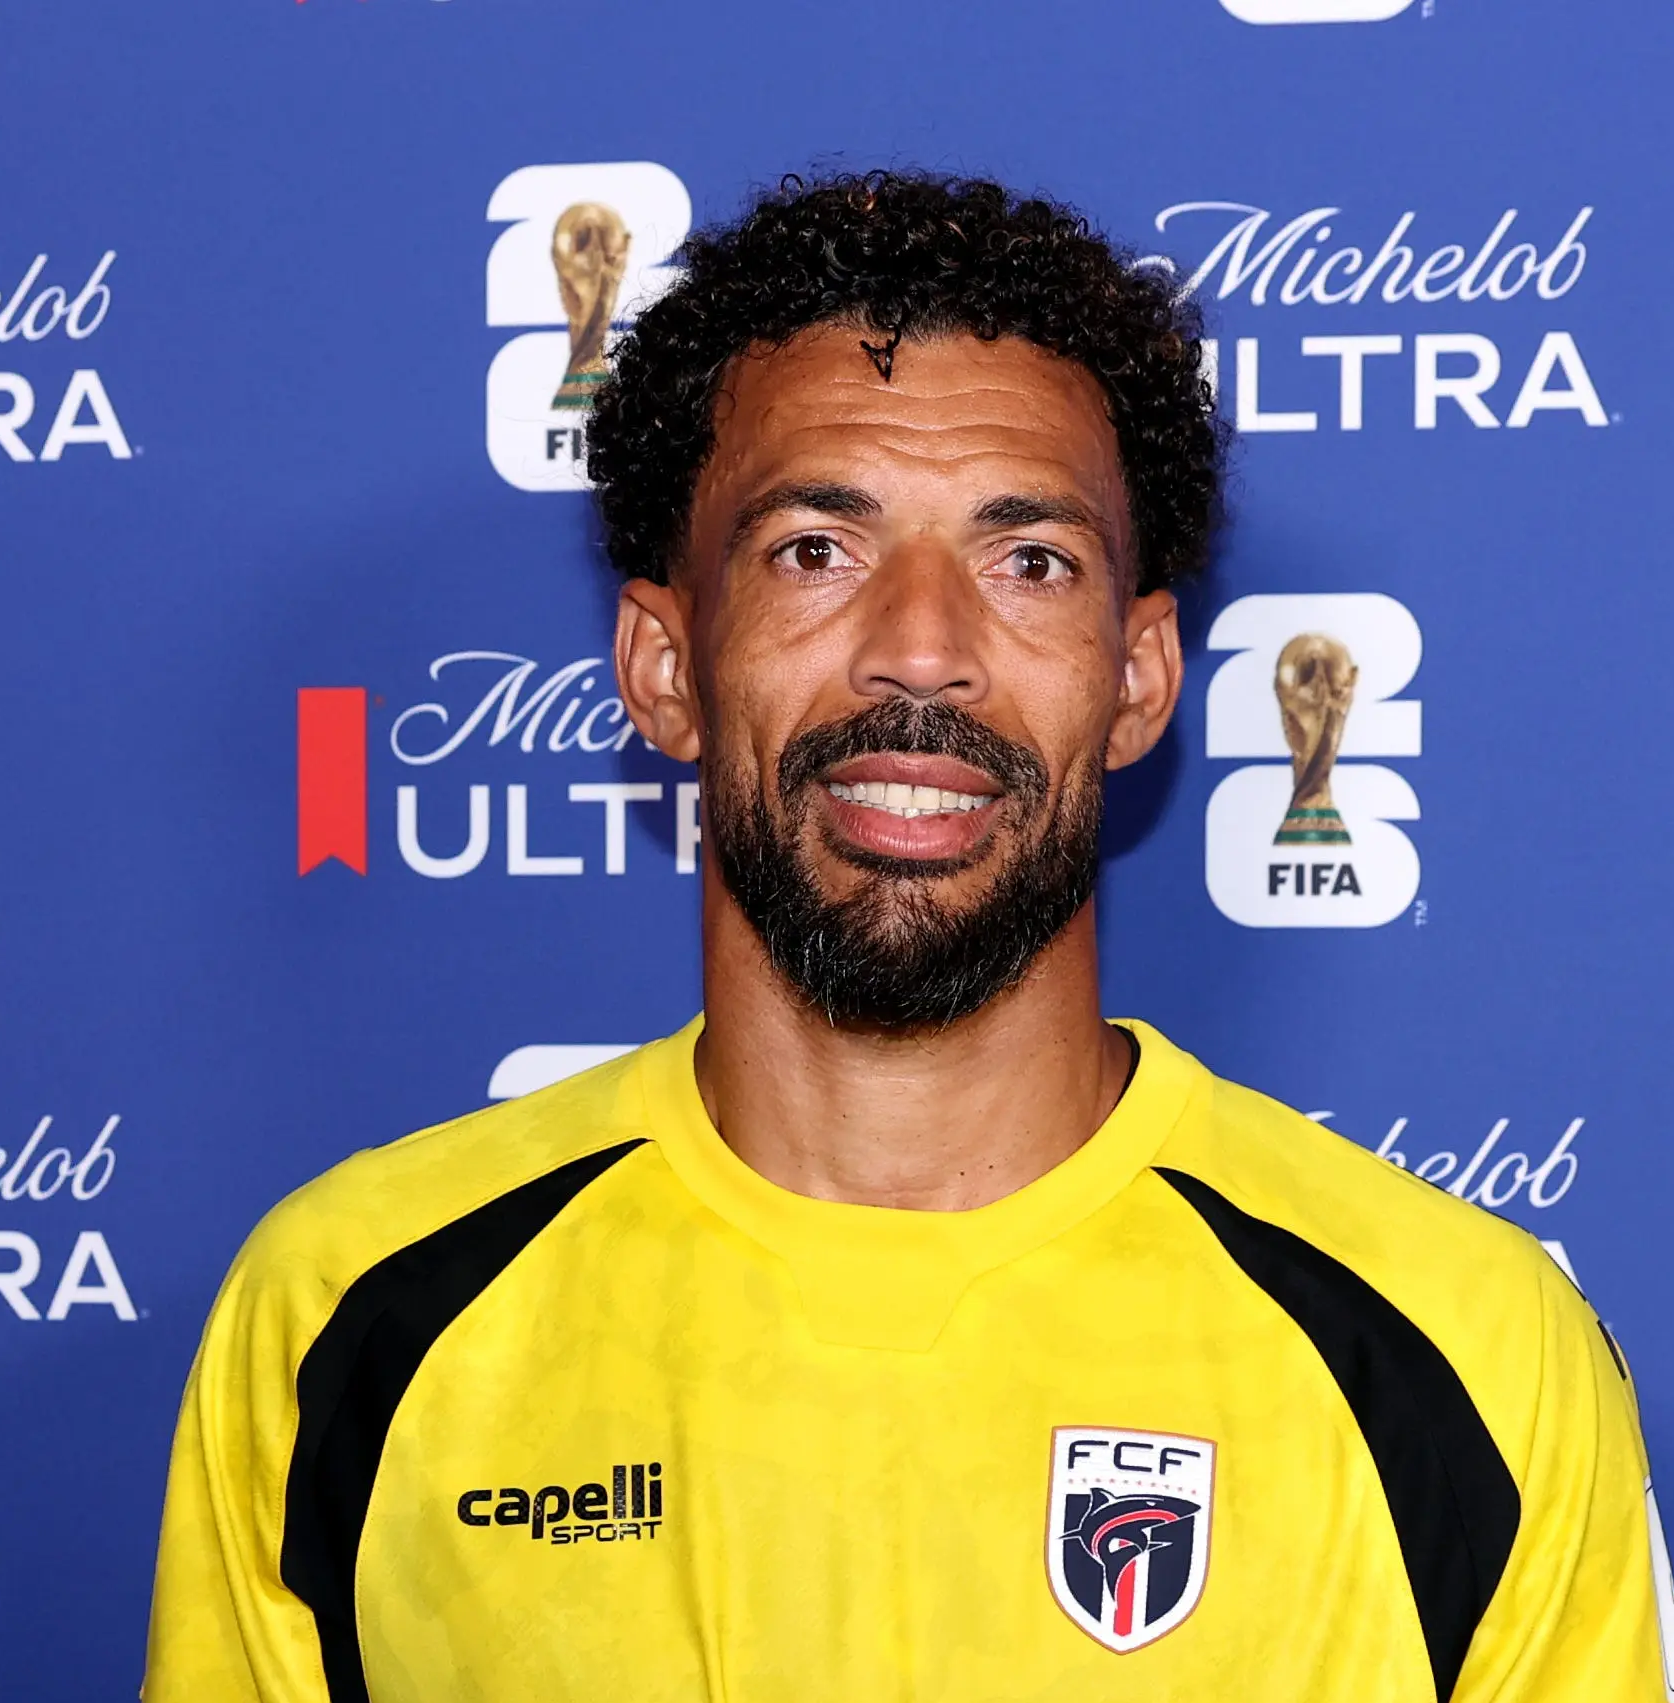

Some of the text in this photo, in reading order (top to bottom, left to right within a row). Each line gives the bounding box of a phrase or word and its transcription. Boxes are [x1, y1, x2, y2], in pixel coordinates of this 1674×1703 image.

[1128, 201, 1594, 306] Michelob
[1197, 331, 1610, 433] LTRA
[397, 783, 701, 878] ULT
[1269, 864, 1361, 896] FIFA
[1067, 1439, 1201, 1477] FCF
[457, 1461, 663, 1541] capelli
[550, 1520, 663, 1546] SPORT
